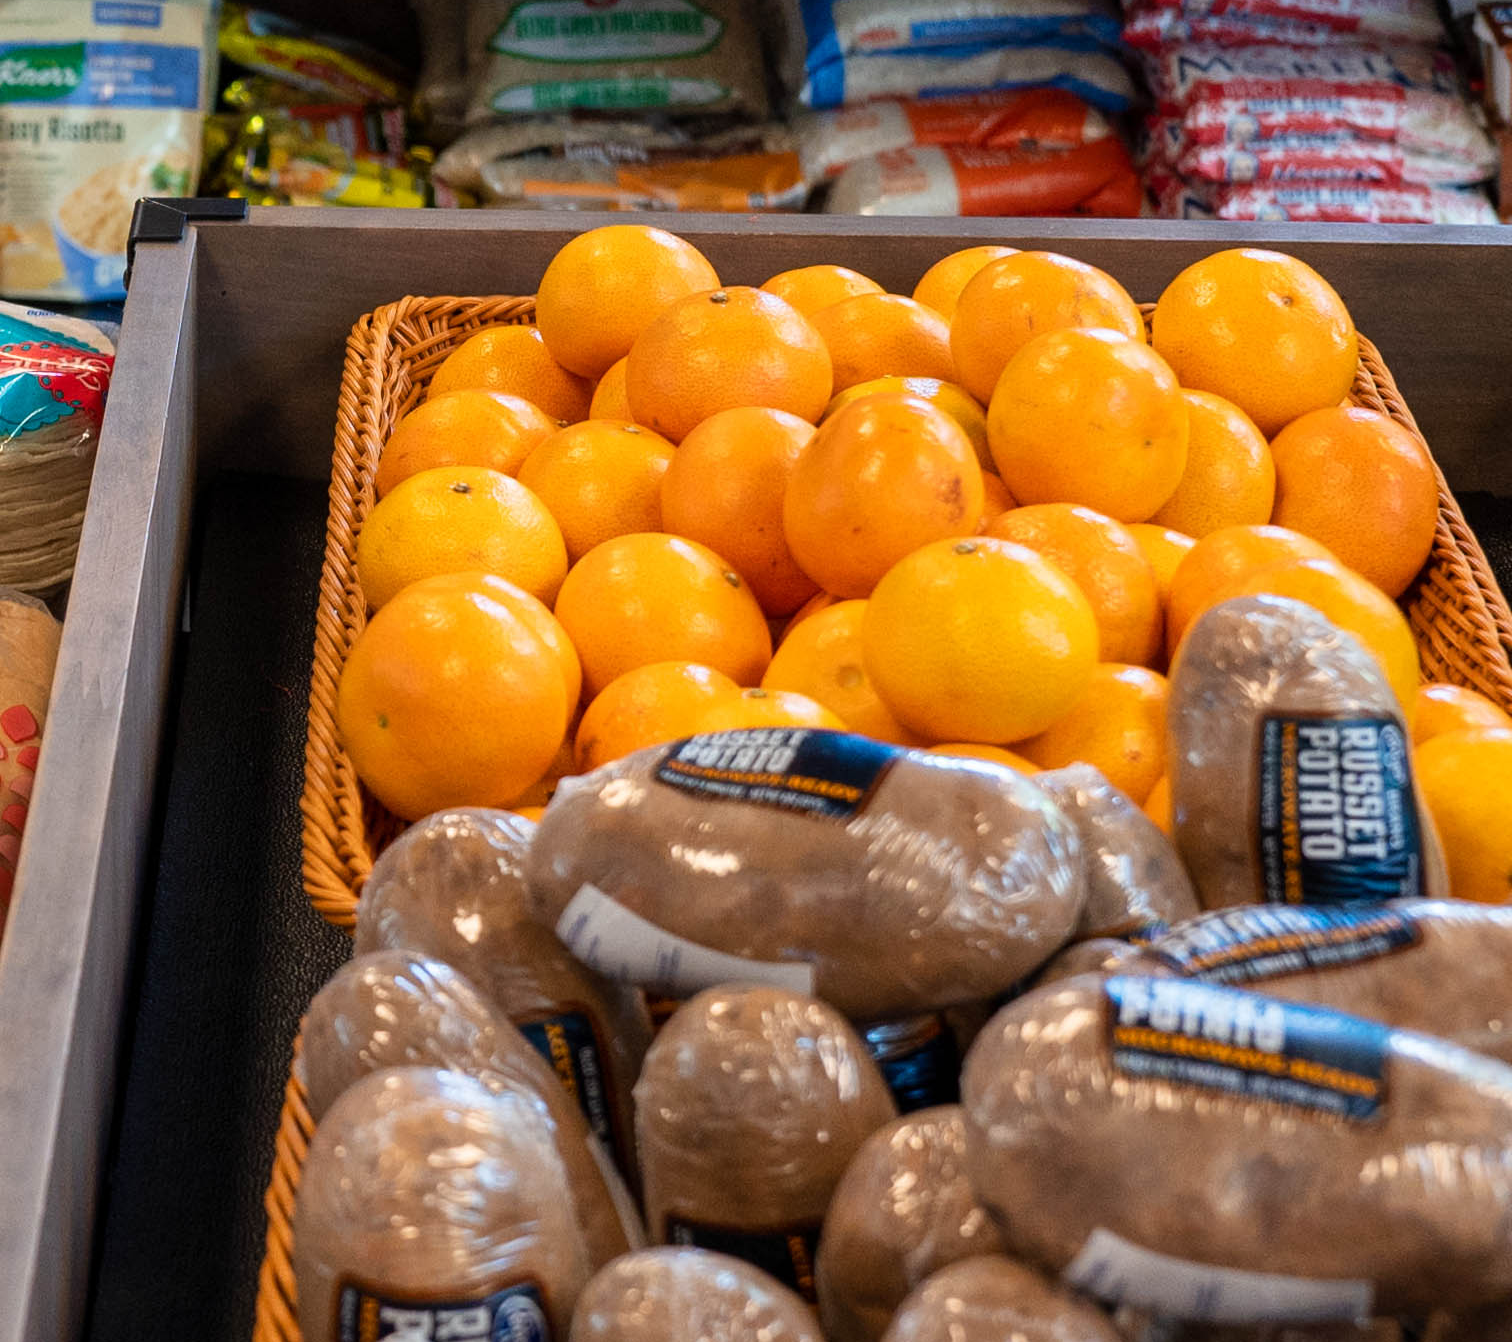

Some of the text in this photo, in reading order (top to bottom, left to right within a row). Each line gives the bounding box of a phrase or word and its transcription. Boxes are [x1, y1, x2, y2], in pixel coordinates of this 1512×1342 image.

[47, 117, 125, 142] Risotto
[1298, 727, 1345, 859] POTATO
[1341, 727, 1387, 859] RUSSET
